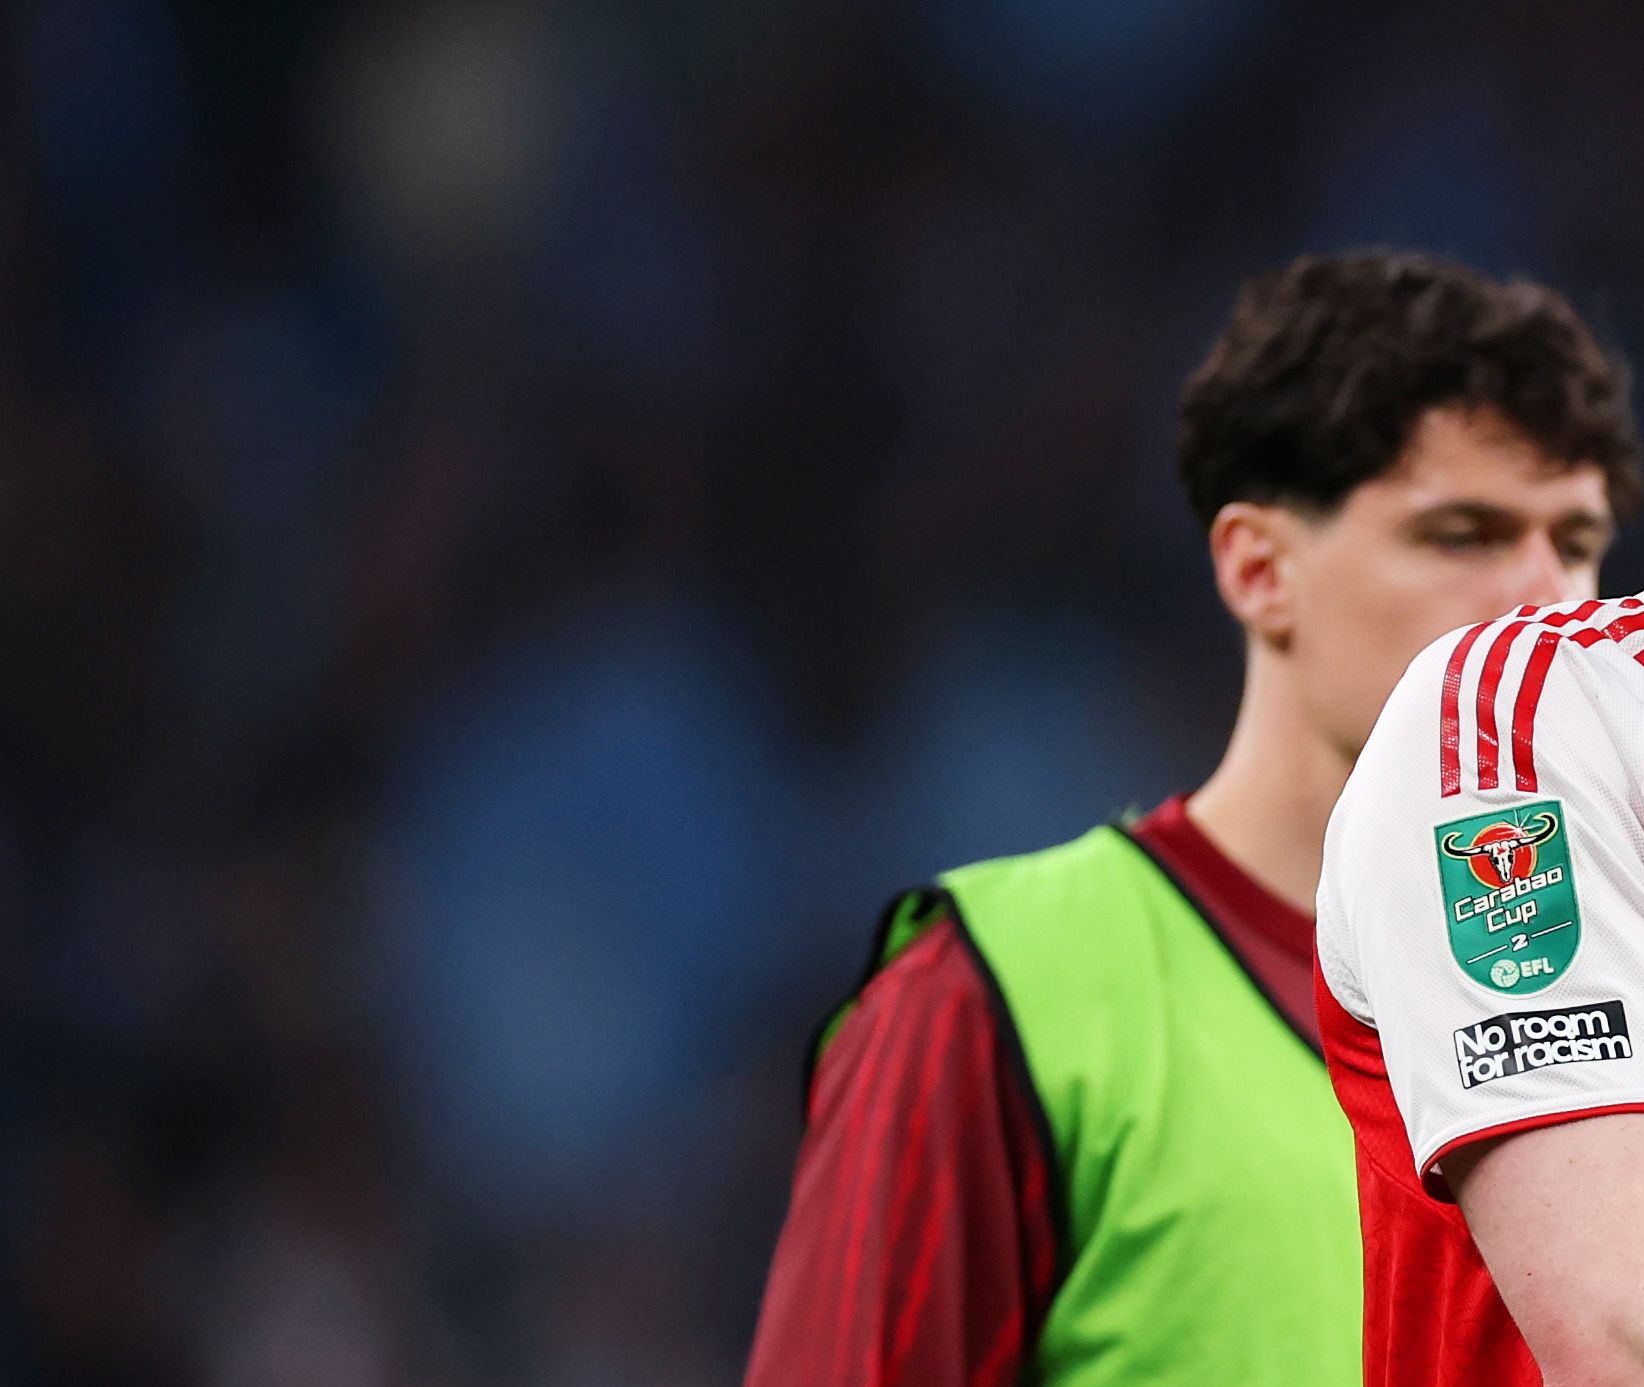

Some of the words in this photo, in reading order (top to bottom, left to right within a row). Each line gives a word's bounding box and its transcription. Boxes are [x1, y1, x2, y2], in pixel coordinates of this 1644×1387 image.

[1454, 865, 1563, 922] Carabao
[1485, 899, 1538, 933] Cup
[1510, 933, 1529, 953] 2
[1520, 957, 1555, 980] EFL
[1454, 1022, 1506, 1062] No
[1510, 1009, 1610, 1042] room
[1458, 1050, 1510, 1089] for
[1513, 1033, 1632, 1073] racism
